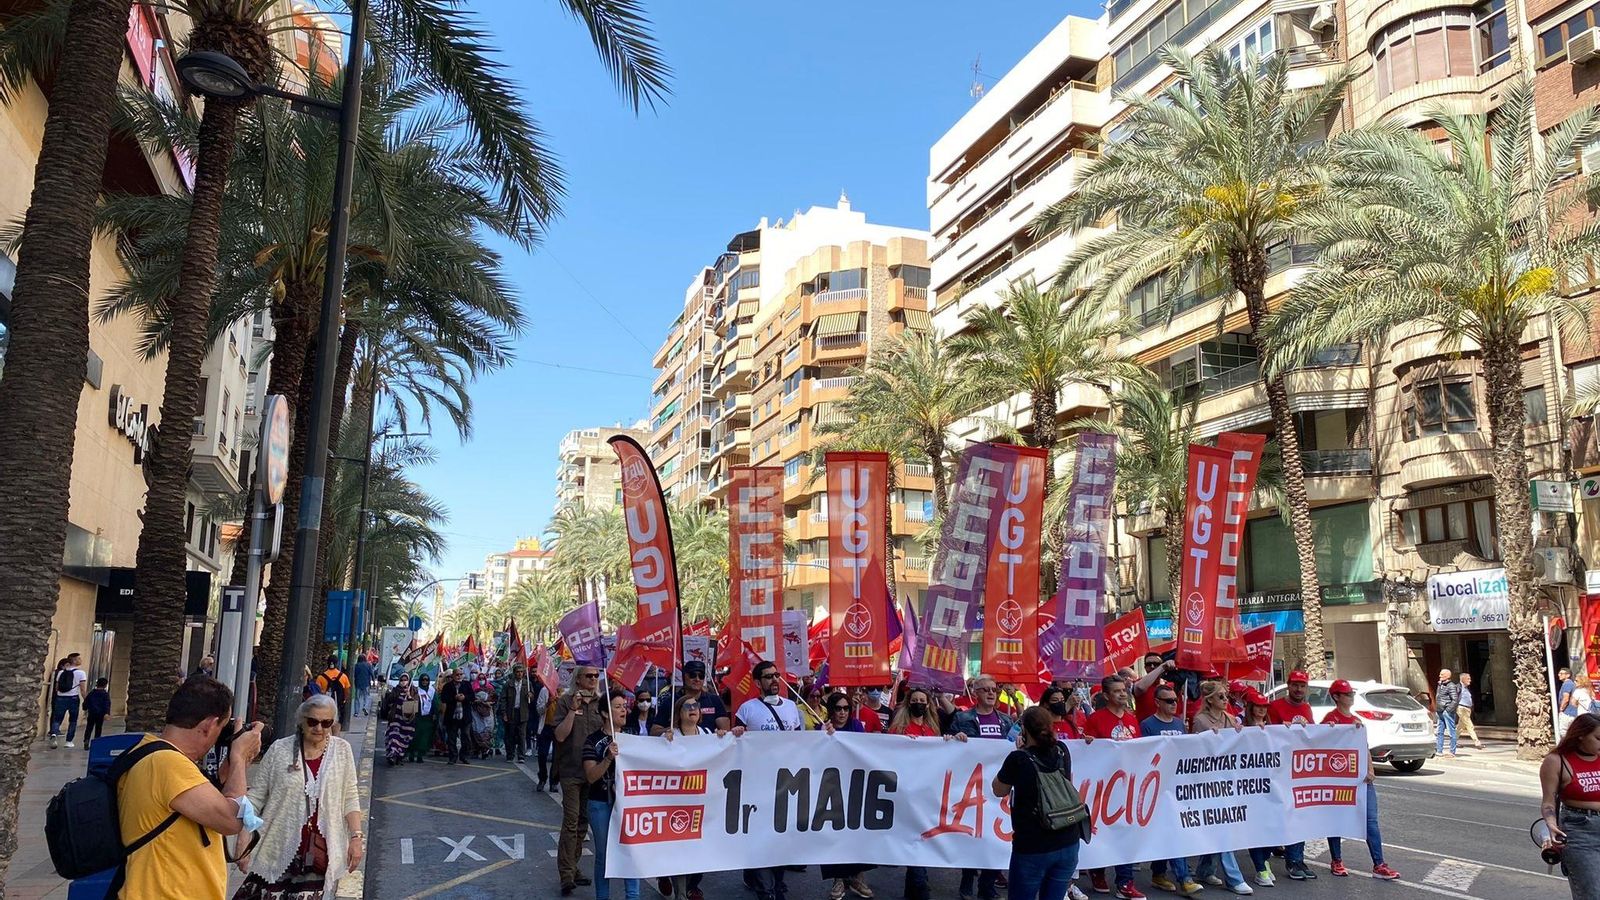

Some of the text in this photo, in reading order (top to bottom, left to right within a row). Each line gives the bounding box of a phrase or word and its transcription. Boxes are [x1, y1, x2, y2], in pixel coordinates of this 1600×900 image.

[841, 468, 870, 599] UGT
[999, 463, 1030, 596] UGT
[1064, 447, 1109, 627] CCOO
[1190, 461, 1219, 588] UGT
[930, 456, 1005, 638] CCOO
[1481, 613, 1496, 623] 965
[1176, 751, 1281, 775] AUGMENTAR SALARIS
[1293, 753, 1327, 773] UGT
[627, 775, 681, 791] CCOO
[1175, 778, 1271, 801] CONTINDRE PREUS
[1295, 788, 1335, 804] CCOO
[921, 762, 987, 840] LA
[624, 811, 667, 838] UGT
[1180, 804, 1248, 829] MÉS IGUALTAT
